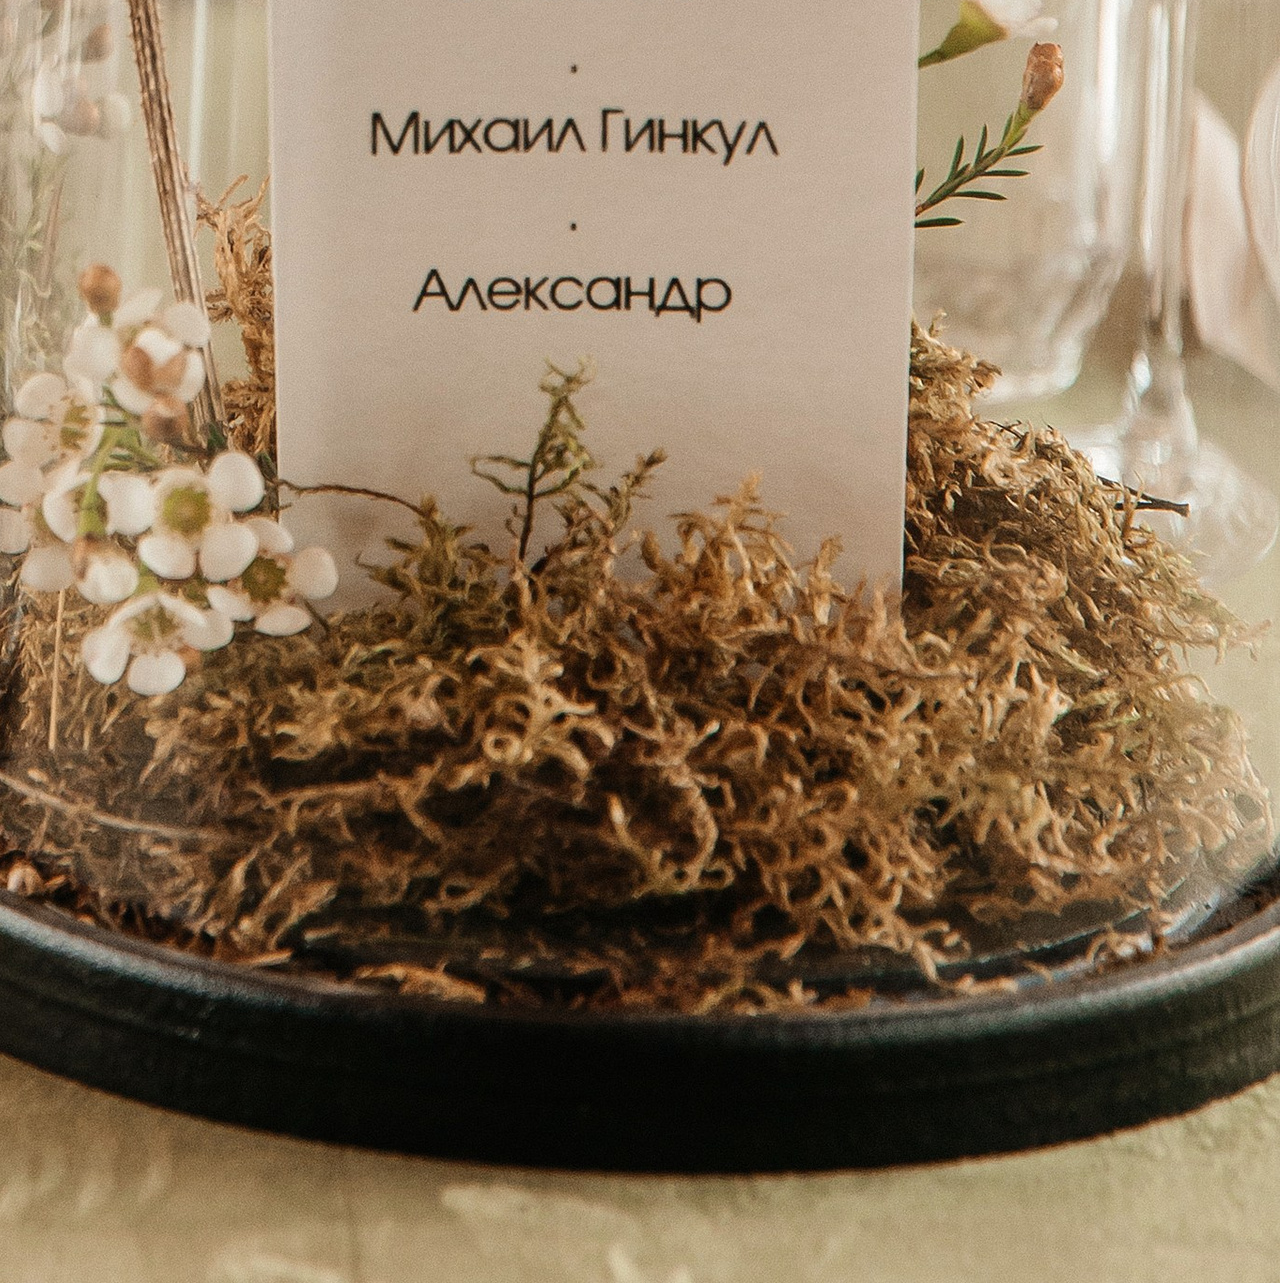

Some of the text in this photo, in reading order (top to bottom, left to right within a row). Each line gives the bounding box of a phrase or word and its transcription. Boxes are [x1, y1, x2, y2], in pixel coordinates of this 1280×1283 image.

[371, 108, 778, 165] Михаил Гинкул
[413, 269, 732, 323] Александр
